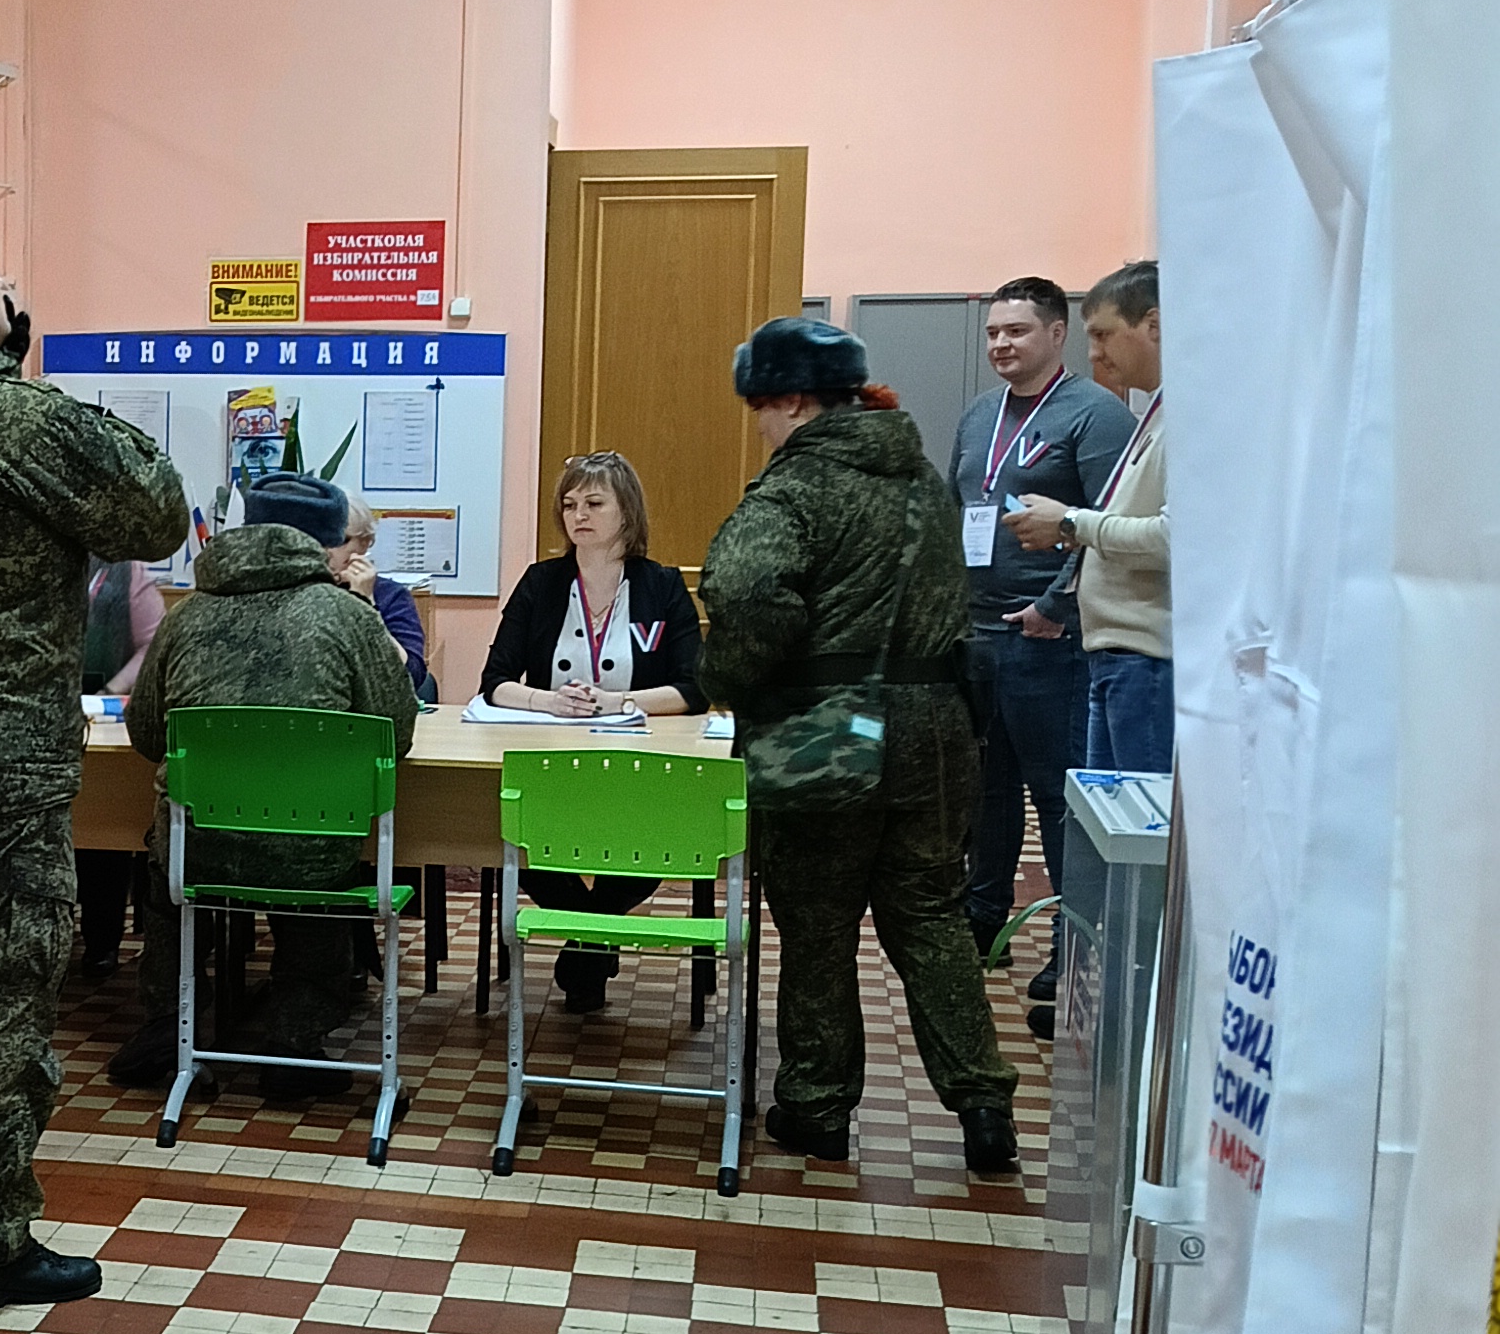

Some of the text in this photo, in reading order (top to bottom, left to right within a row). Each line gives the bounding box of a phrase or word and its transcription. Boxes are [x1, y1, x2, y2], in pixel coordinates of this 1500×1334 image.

[327, 234, 425, 249] УЧАСТКОВАЯ
[313, 251, 438, 265] ИЗБИРАТЕЛЬНАЯ
[211, 263, 298, 279] ВНИМАНИЕ!
[332, 268, 418, 282] КОМИССИЯ
[248, 294, 295, 308] ВЕДЕТСЯ
[105, 340, 440, 367] ИНФОРМАЦИЯ
